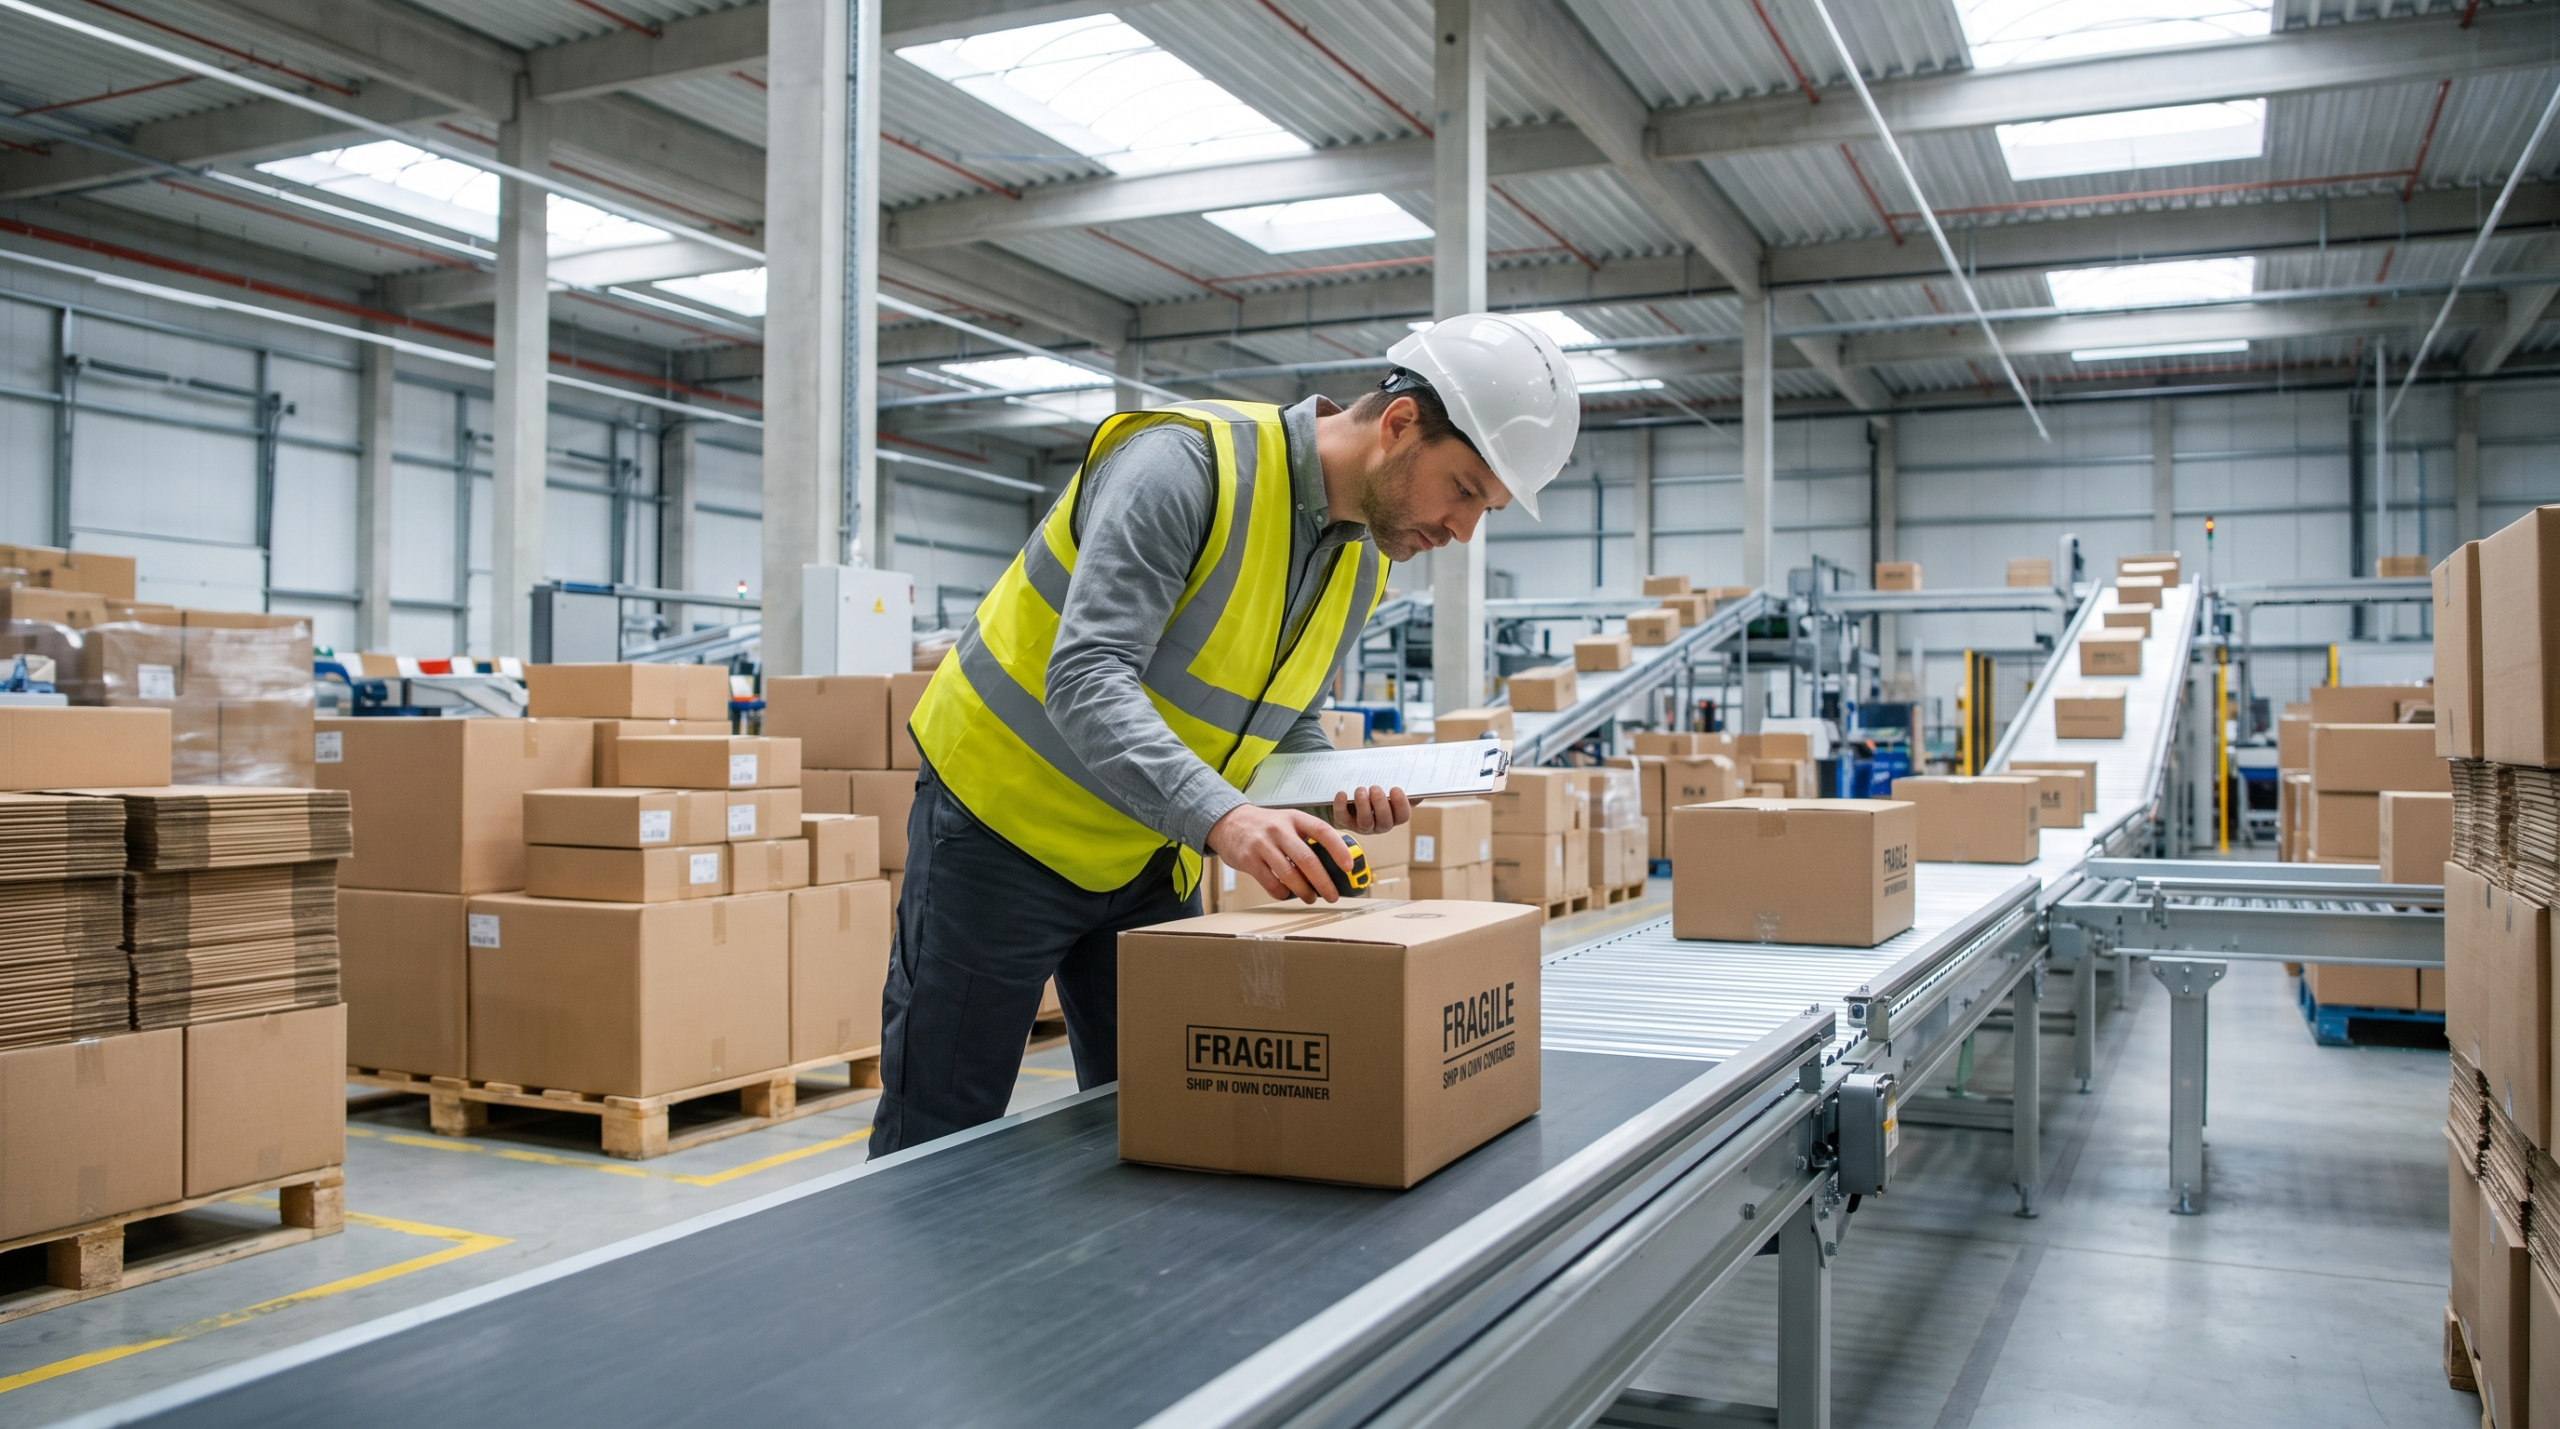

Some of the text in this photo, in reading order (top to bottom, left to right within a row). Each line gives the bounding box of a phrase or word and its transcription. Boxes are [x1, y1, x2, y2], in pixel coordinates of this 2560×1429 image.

[1444, 982, 1514, 1053] FRAGILE
[1195, 1034, 1321, 1072] FRAGILE
[1186, 1077, 1330, 1100] SHIP IN OWN CONTAINER
[1443, 1067, 1459, 1089] SHIP
[1460, 1063, 1467, 1082] IN
